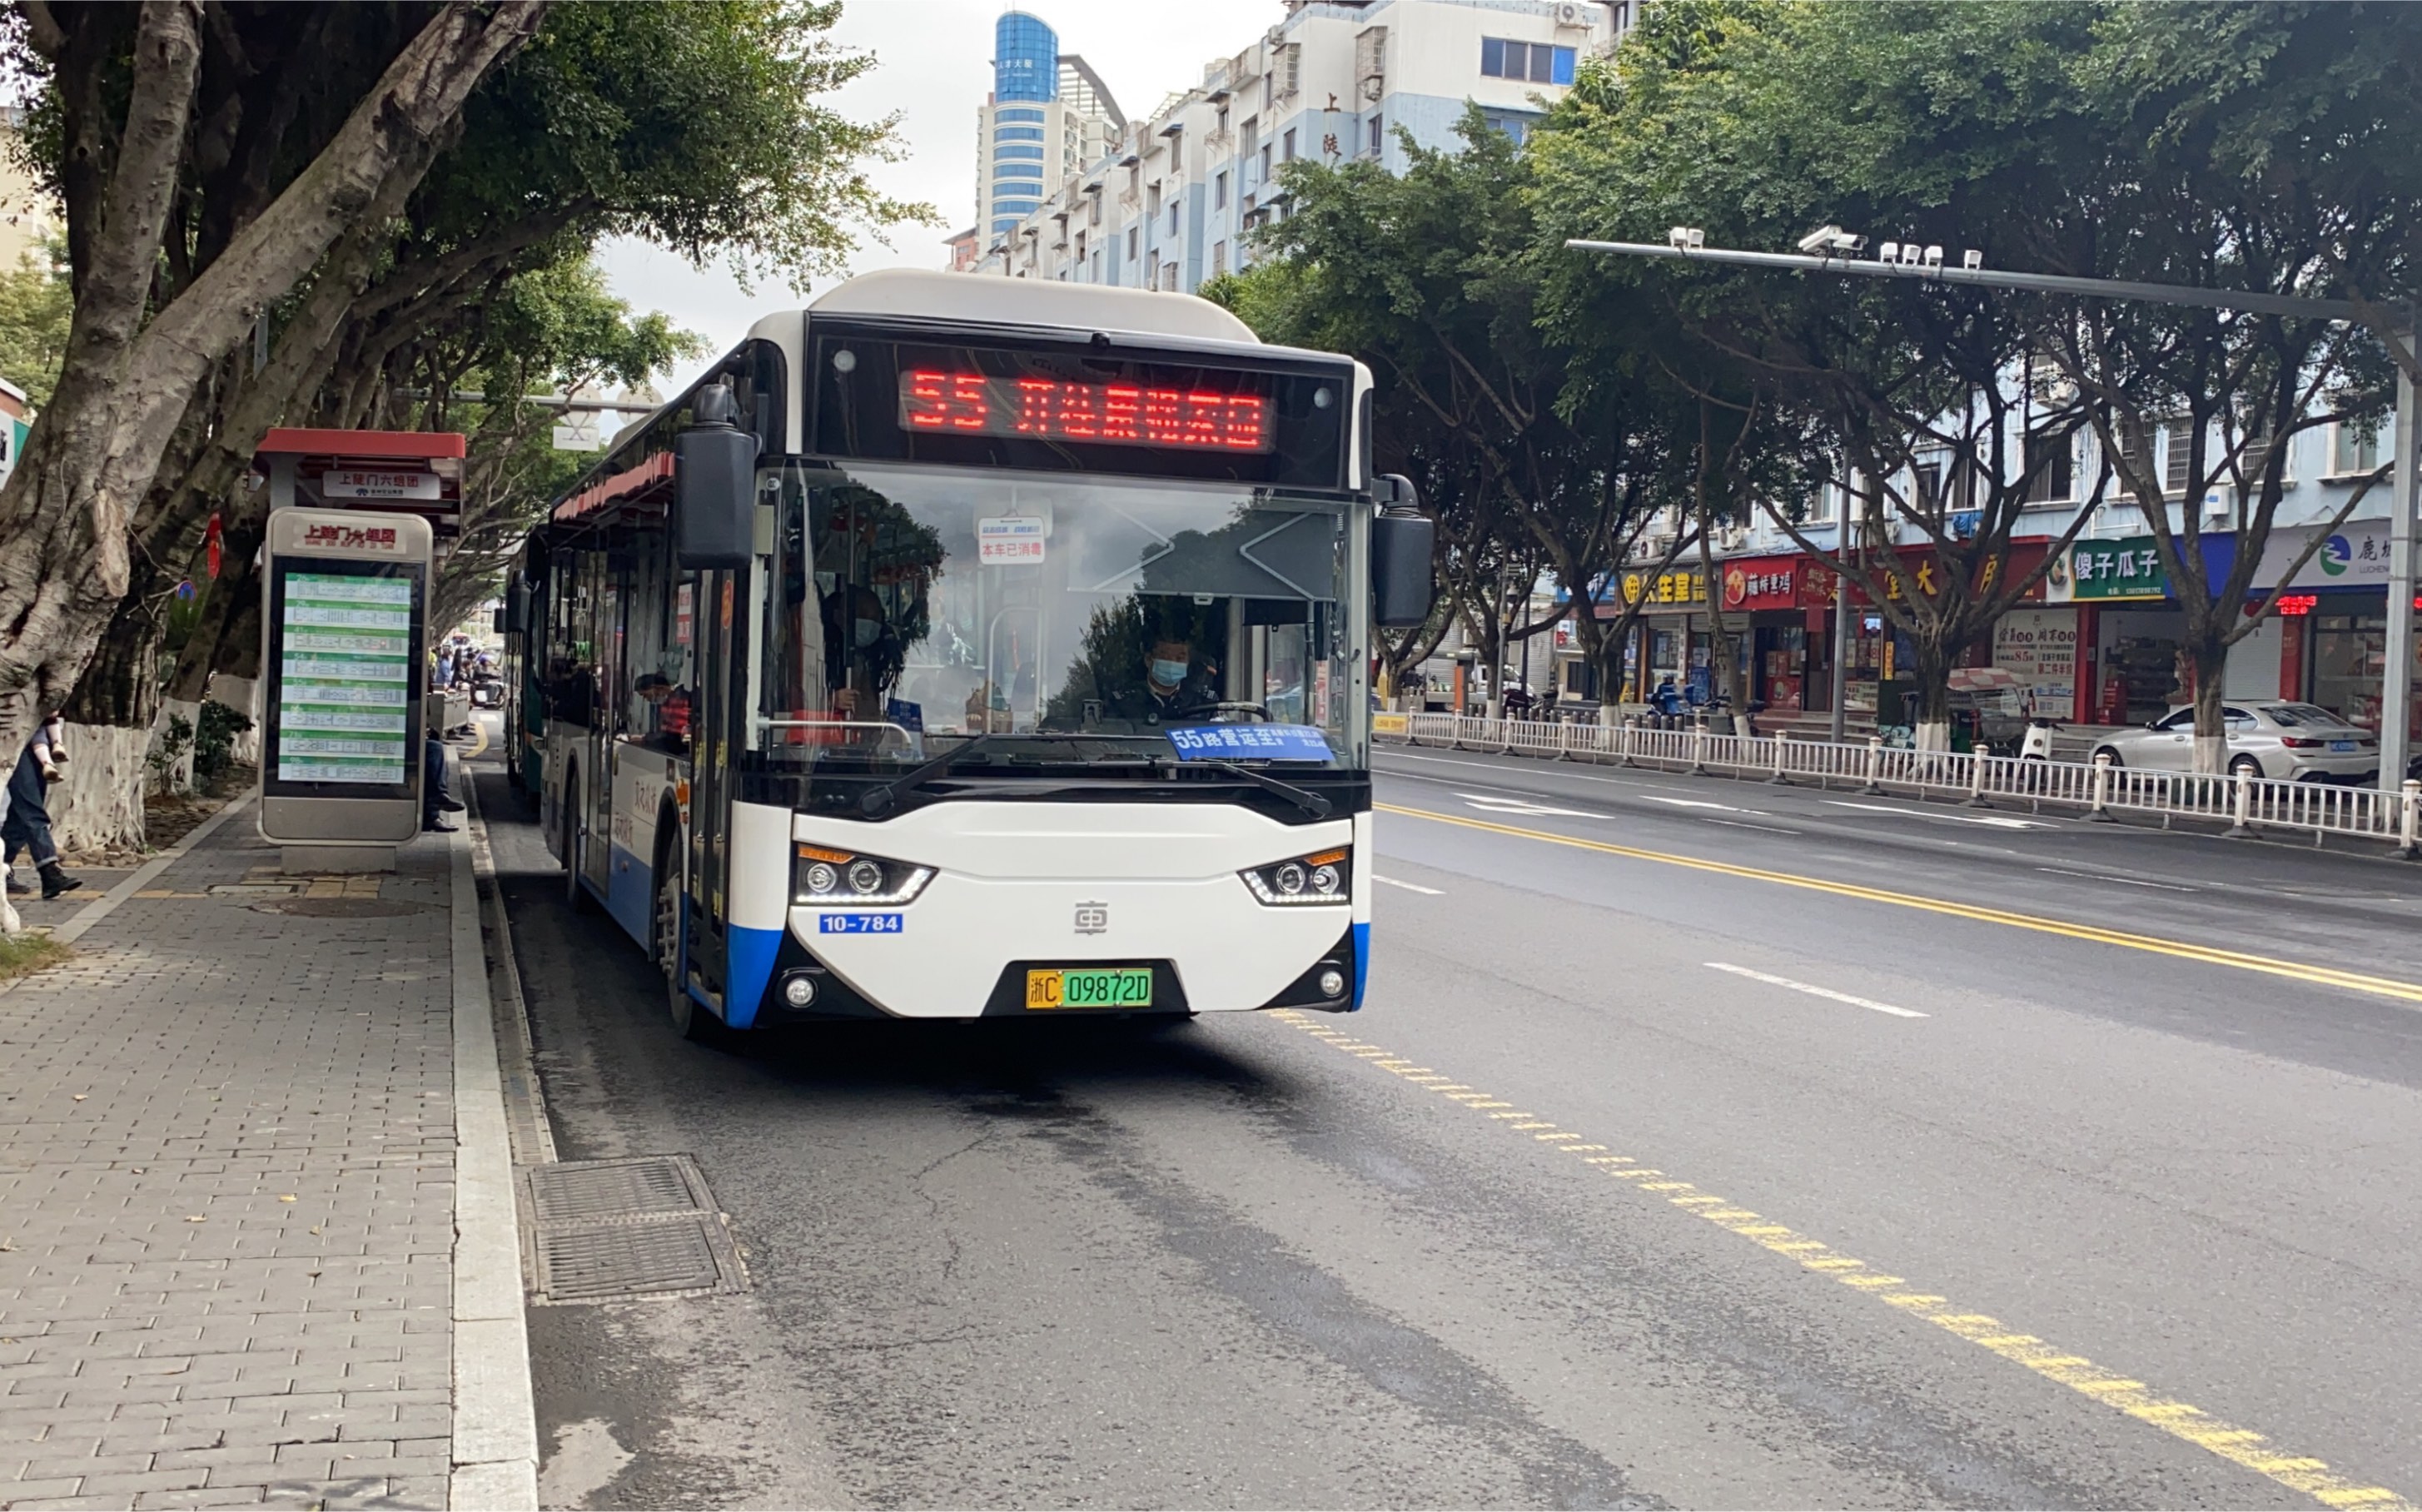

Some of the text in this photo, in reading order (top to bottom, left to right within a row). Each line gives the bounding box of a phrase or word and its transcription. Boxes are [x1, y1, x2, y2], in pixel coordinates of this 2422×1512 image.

[915, 373, 985, 428] 55
[339, 473, 419, 488] 上陡门六组团
[304, 524, 396, 543] 上陡门六组团
[982, 542, 1042, 557] 本车已消毒
[2074, 550, 2159, 580] 傻子瓜子
[1171, 728, 1276, 749] 55路营运至
[823, 916, 899, 932] 10-784
